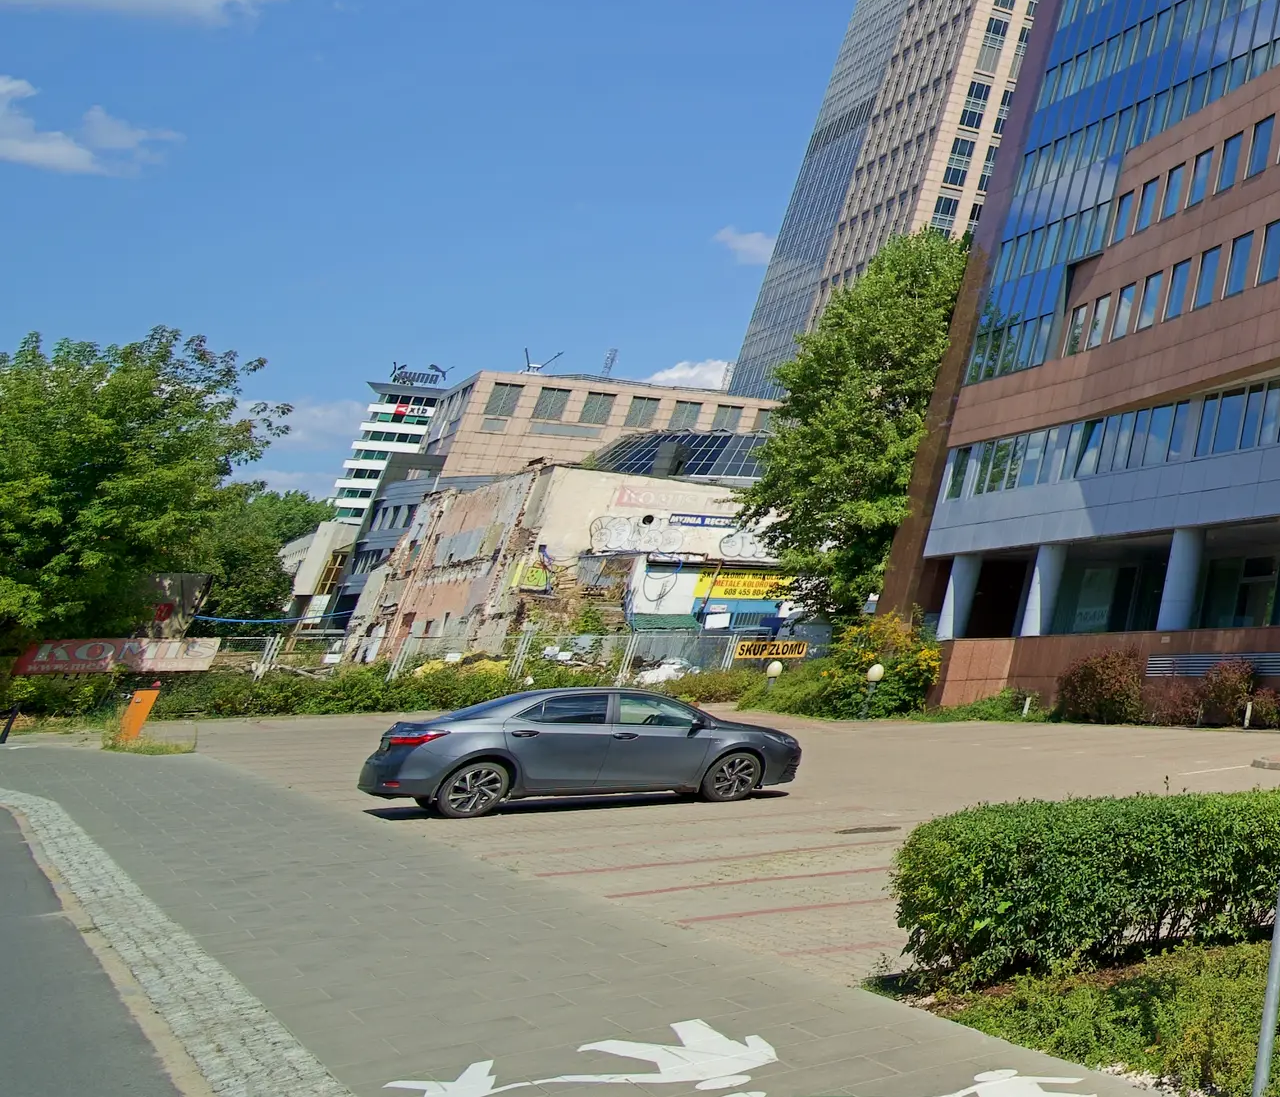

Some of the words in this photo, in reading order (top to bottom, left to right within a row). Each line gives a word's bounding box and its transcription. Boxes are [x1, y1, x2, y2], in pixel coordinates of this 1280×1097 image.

[399, 371, 440, 385] PUMA
[408, 406, 428, 415] xtb
[669, 515, 702, 524] MYJNIA
[715, 579, 741, 588] METALE
[33, 642, 216, 663] KOMIS
[738, 642, 768, 656] SKUP
[768, 642, 806, 656] ZŁOMU
